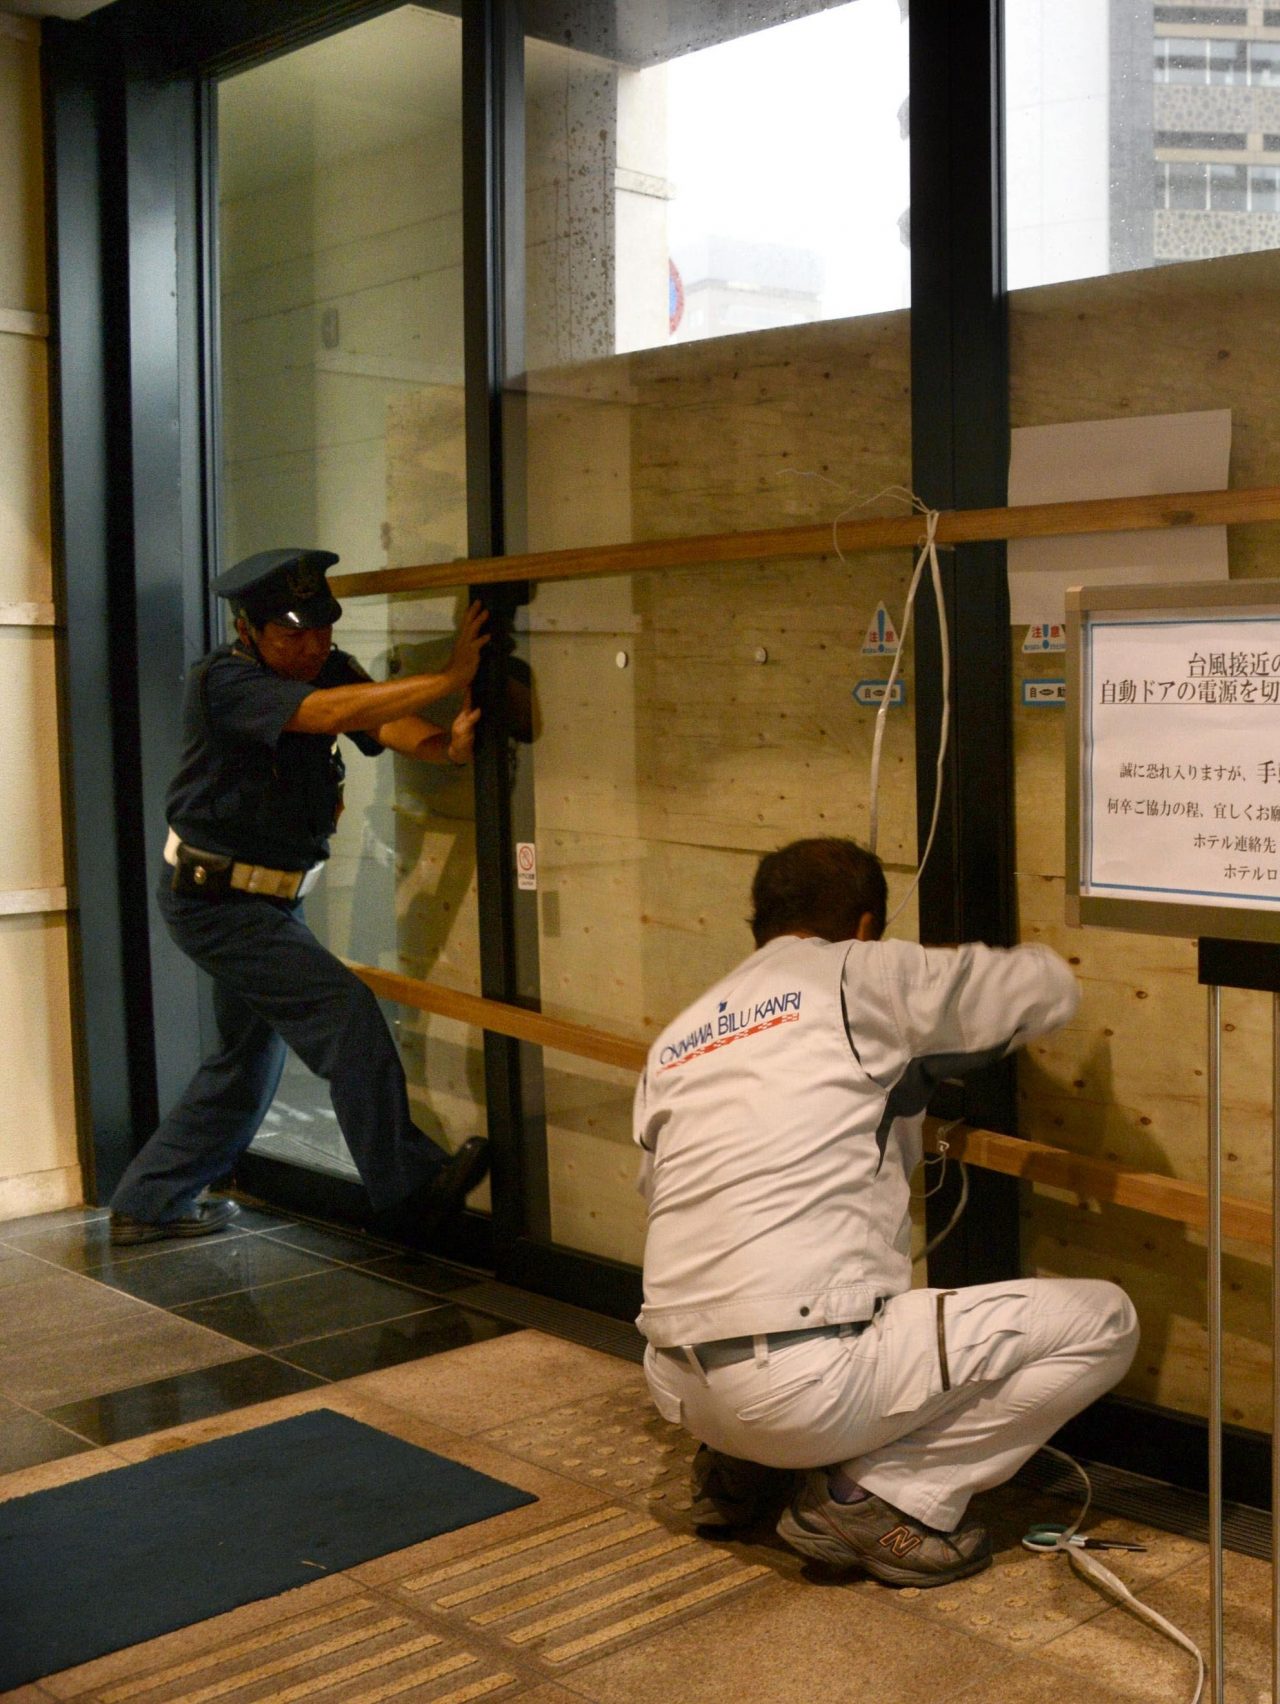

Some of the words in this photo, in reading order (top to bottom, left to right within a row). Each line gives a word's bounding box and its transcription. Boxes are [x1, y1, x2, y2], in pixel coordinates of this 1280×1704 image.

[1193, 833, 1277, 854] ホテル連絡先
[717, 1008, 752, 1036] BILU
[753, 991, 801, 1022] KANRI
[879, 1525, 921, 1557] N
